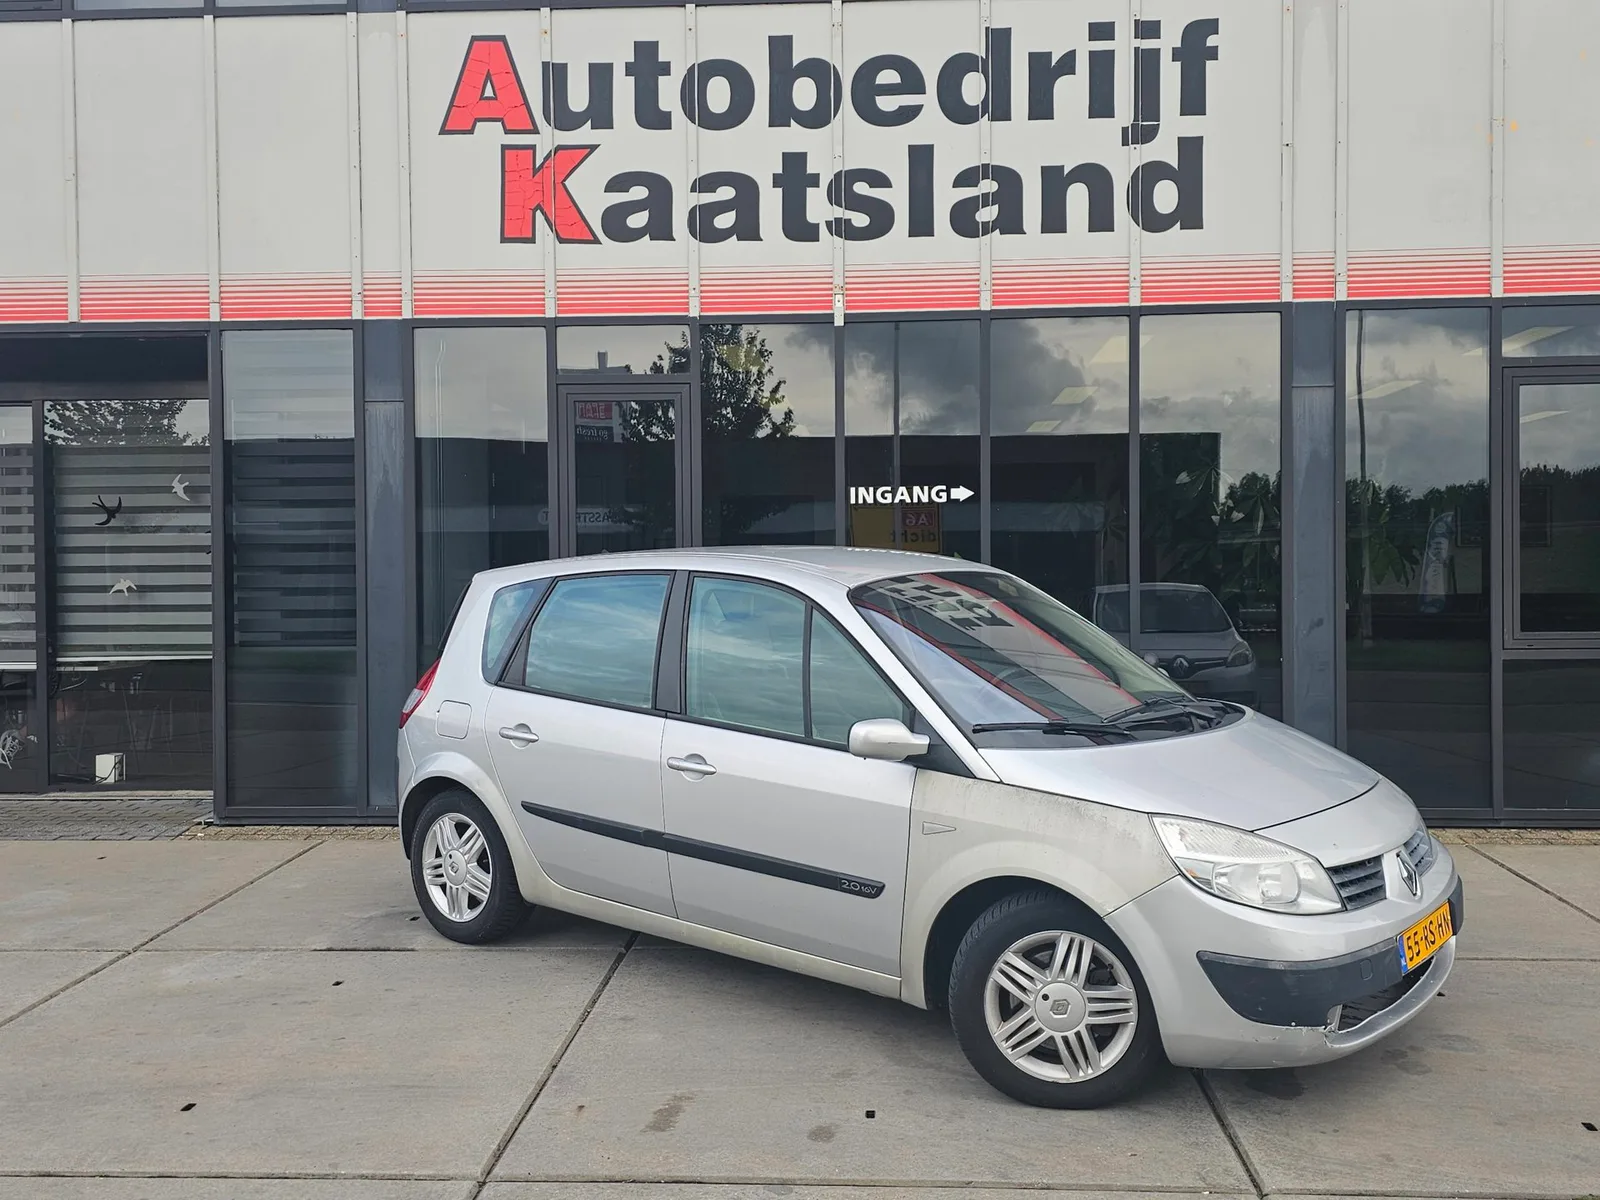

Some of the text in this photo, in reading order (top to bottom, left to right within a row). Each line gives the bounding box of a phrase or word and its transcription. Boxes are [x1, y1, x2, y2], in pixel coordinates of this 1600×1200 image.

[438, 18, 1219, 146] Autobedrijf
[500, 136, 1204, 244] Kaatsland
[850, 485, 948, 504] INGANG
[1406, 908, 1451, 962] 55-RS-HN
